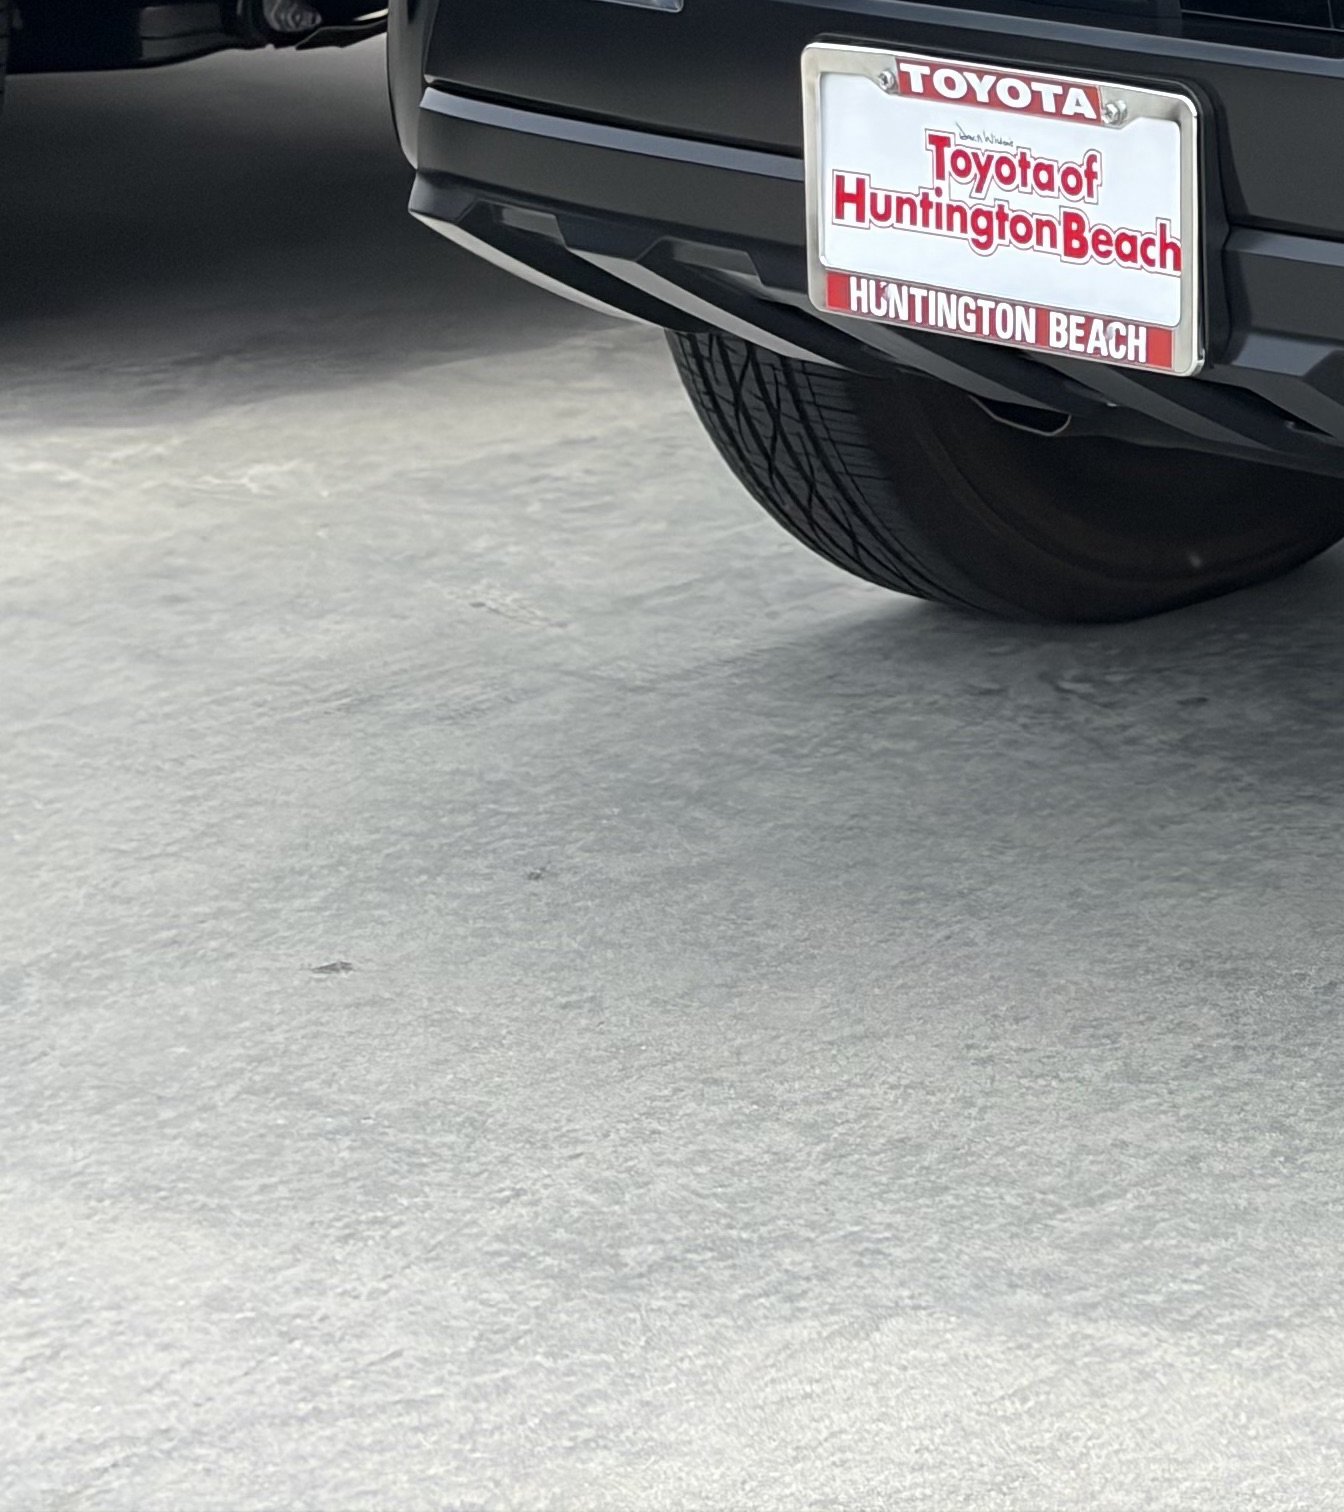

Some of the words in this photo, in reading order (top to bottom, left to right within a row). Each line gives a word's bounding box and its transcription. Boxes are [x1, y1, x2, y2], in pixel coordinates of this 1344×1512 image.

[899, 62, 1098, 120] TOYOTA
[926, 133, 1055, 194] Toyota
[1059, 152, 1099, 199] of
[834, 174, 1057, 251] Huntington
[1062, 210, 1182, 272] Beach
[849, 275, 1037, 345] HUNTINGTON
[1049, 311, 1148, 364] BEACH
